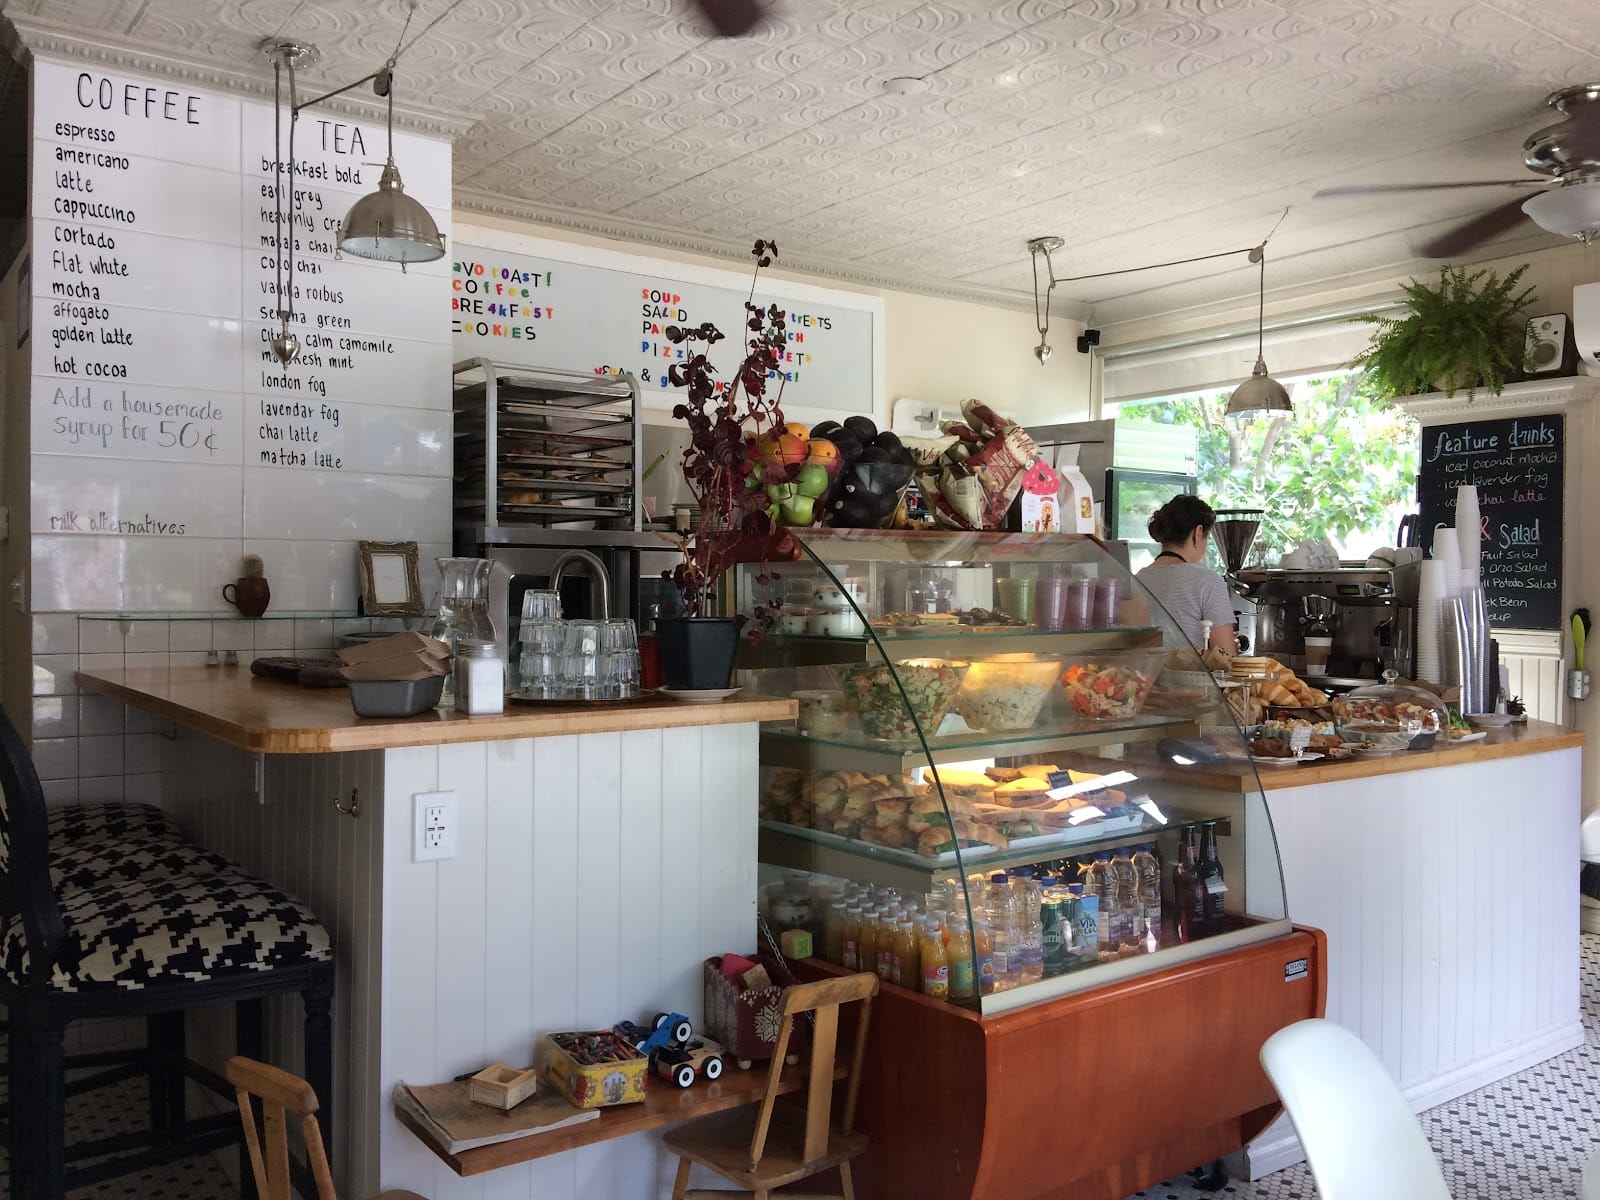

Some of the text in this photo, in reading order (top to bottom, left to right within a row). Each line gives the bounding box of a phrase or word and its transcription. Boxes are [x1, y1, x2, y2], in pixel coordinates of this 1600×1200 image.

[77, 72, 201, 125] COFFEE
[55, 122, 115, 142] espresso
[316, 120, 366, 156] TEA
[56, 147, 130, 170] americano
[262, 155, 362, 185] breakfast bold
[55, 170, 94, 193] latte
[54, 197, 136, 223] cappuccino
[294, 189, 323, 210] grey
[54, 226, 115, 250] cortado
[260, 234, 333, 254] maaa chai
[89, 256, 130, 277] white
[260, 256, 322, 274] coo chai
[52, 280, 100, 300] mocha
[306, 284, 344, 304] roibus
[642, 288, 680, 305] SOUP
[53, 301, 109, 326] affogato
[317, 314, 351, 329] green
[52, 326, 134, 349] golden latte
[305, 333, 333, 349] calm
[339, 337, 394, 354] camomile
[54, 356, 127, 378] hot cocoa
[328, 355, 354, 369] mint
[261, 371, 326, 397] london fog
[641, 368, 652, 382] &
[52, 386, 223, 421] Add a housemade
[260, 399, 339, 427] lavendar fog
[53, 416, 113, 448] Syrup
[122, 415, 149, 441] for
[259, 424, 319, 443] chai latte
[1427, 421, 1555, 462] feature drinks
[260, 447, 343, 469] matcha latte
[1446, 452, 1557, 472] iced coconut mocha
[1445, 468, 1548, 490] iced lavender fog
[1511, 489, 1546, 502] latte
[50, 510, 186, 535] milk alternatives
[1480, 516, 1541, 549] & Salad
[1506, 548, 1538, 560] Salad
[1515, 562, 1548, 573] Salad
[1493, 577, 1524, 588] Potato
[1525, 577, 1557, 589] Salad
[1498, 596, 1528, 608] Bean
[1488, 613, 1511, 623] oup
